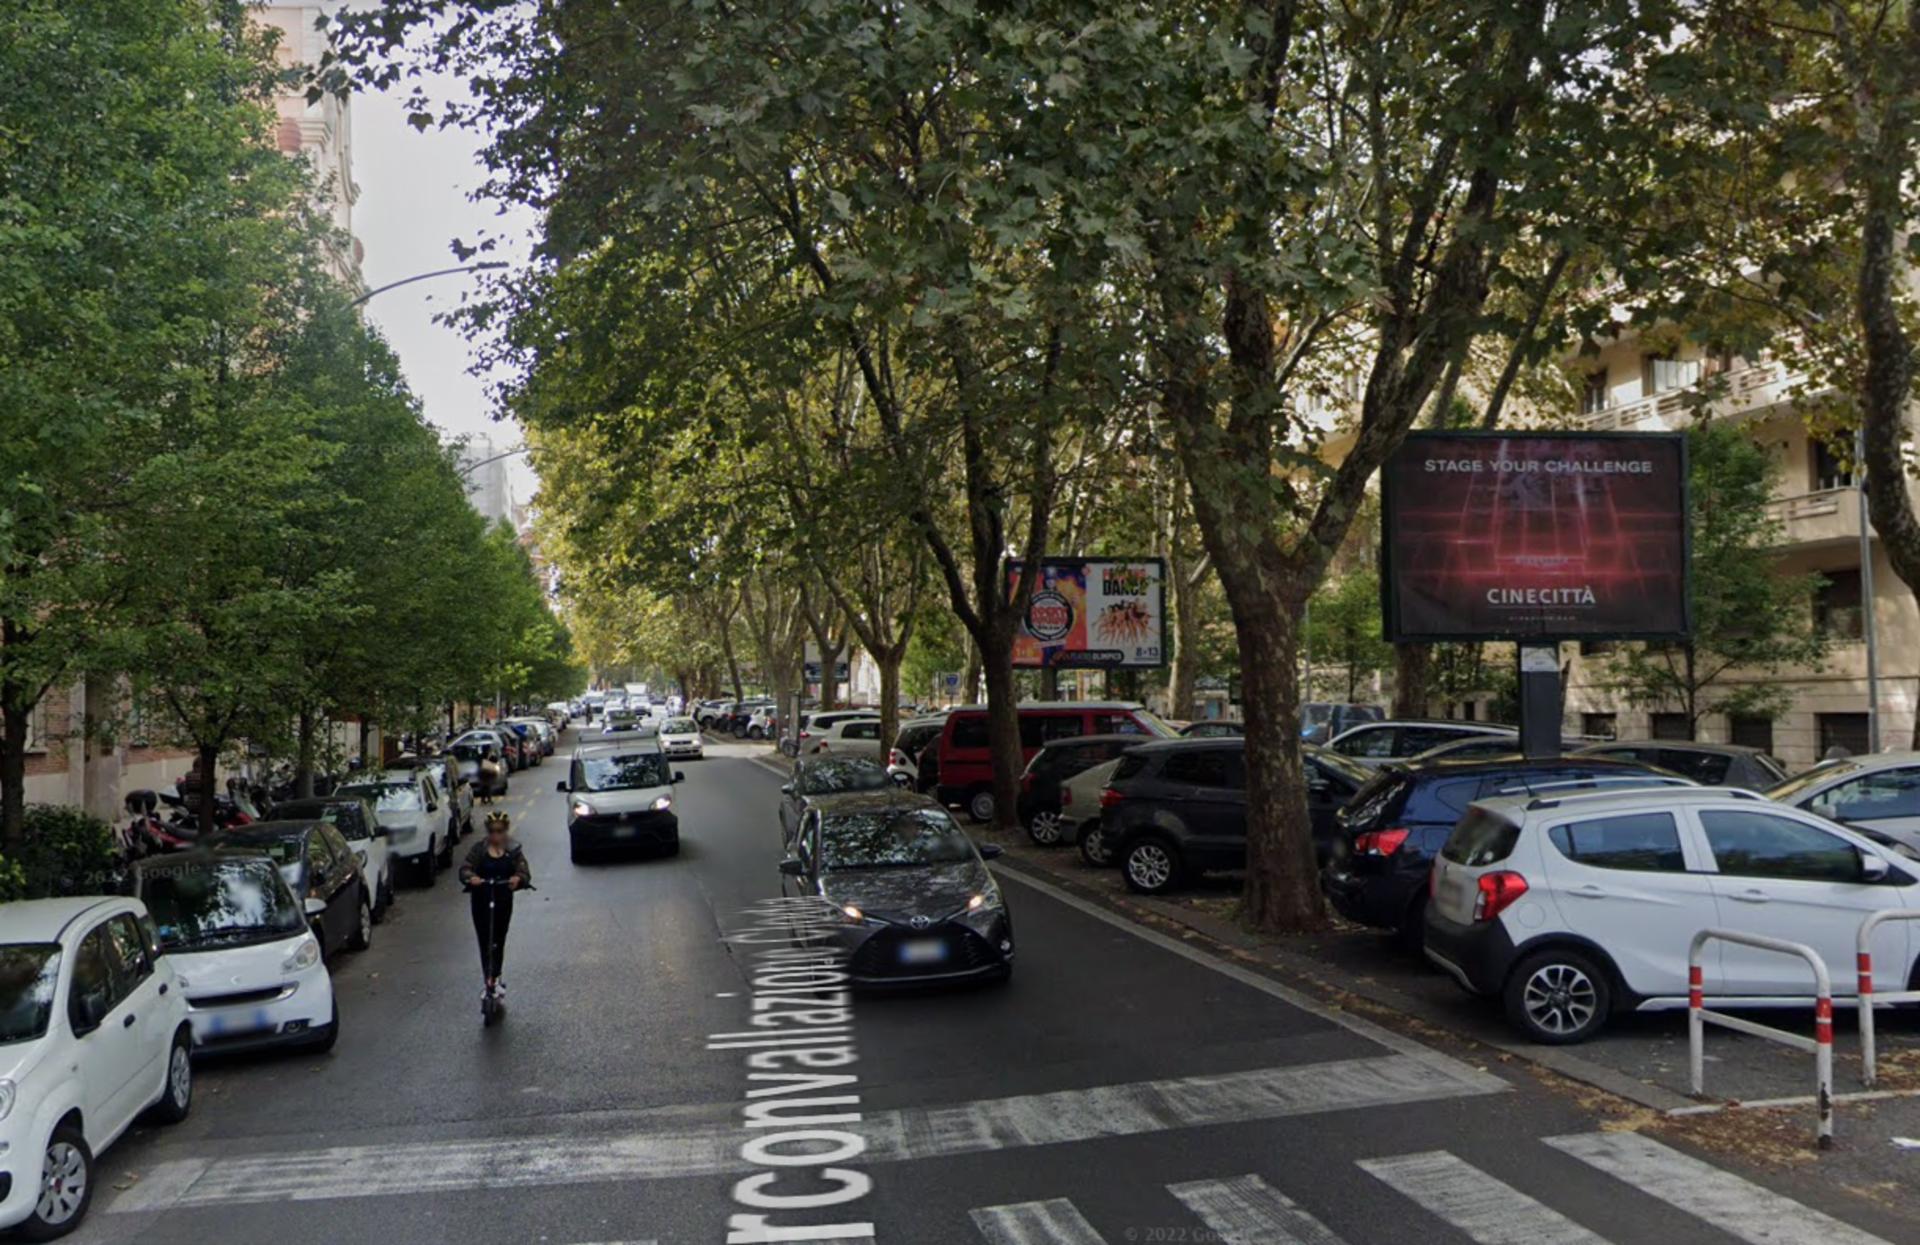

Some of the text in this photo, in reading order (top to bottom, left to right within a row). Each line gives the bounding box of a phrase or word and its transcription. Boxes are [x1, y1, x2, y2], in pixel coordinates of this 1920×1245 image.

[1424, 459, 1653, 474] STAGE YOUR CHALLENGE
[1486, 585, 1597, 605] CINECITTÀ
